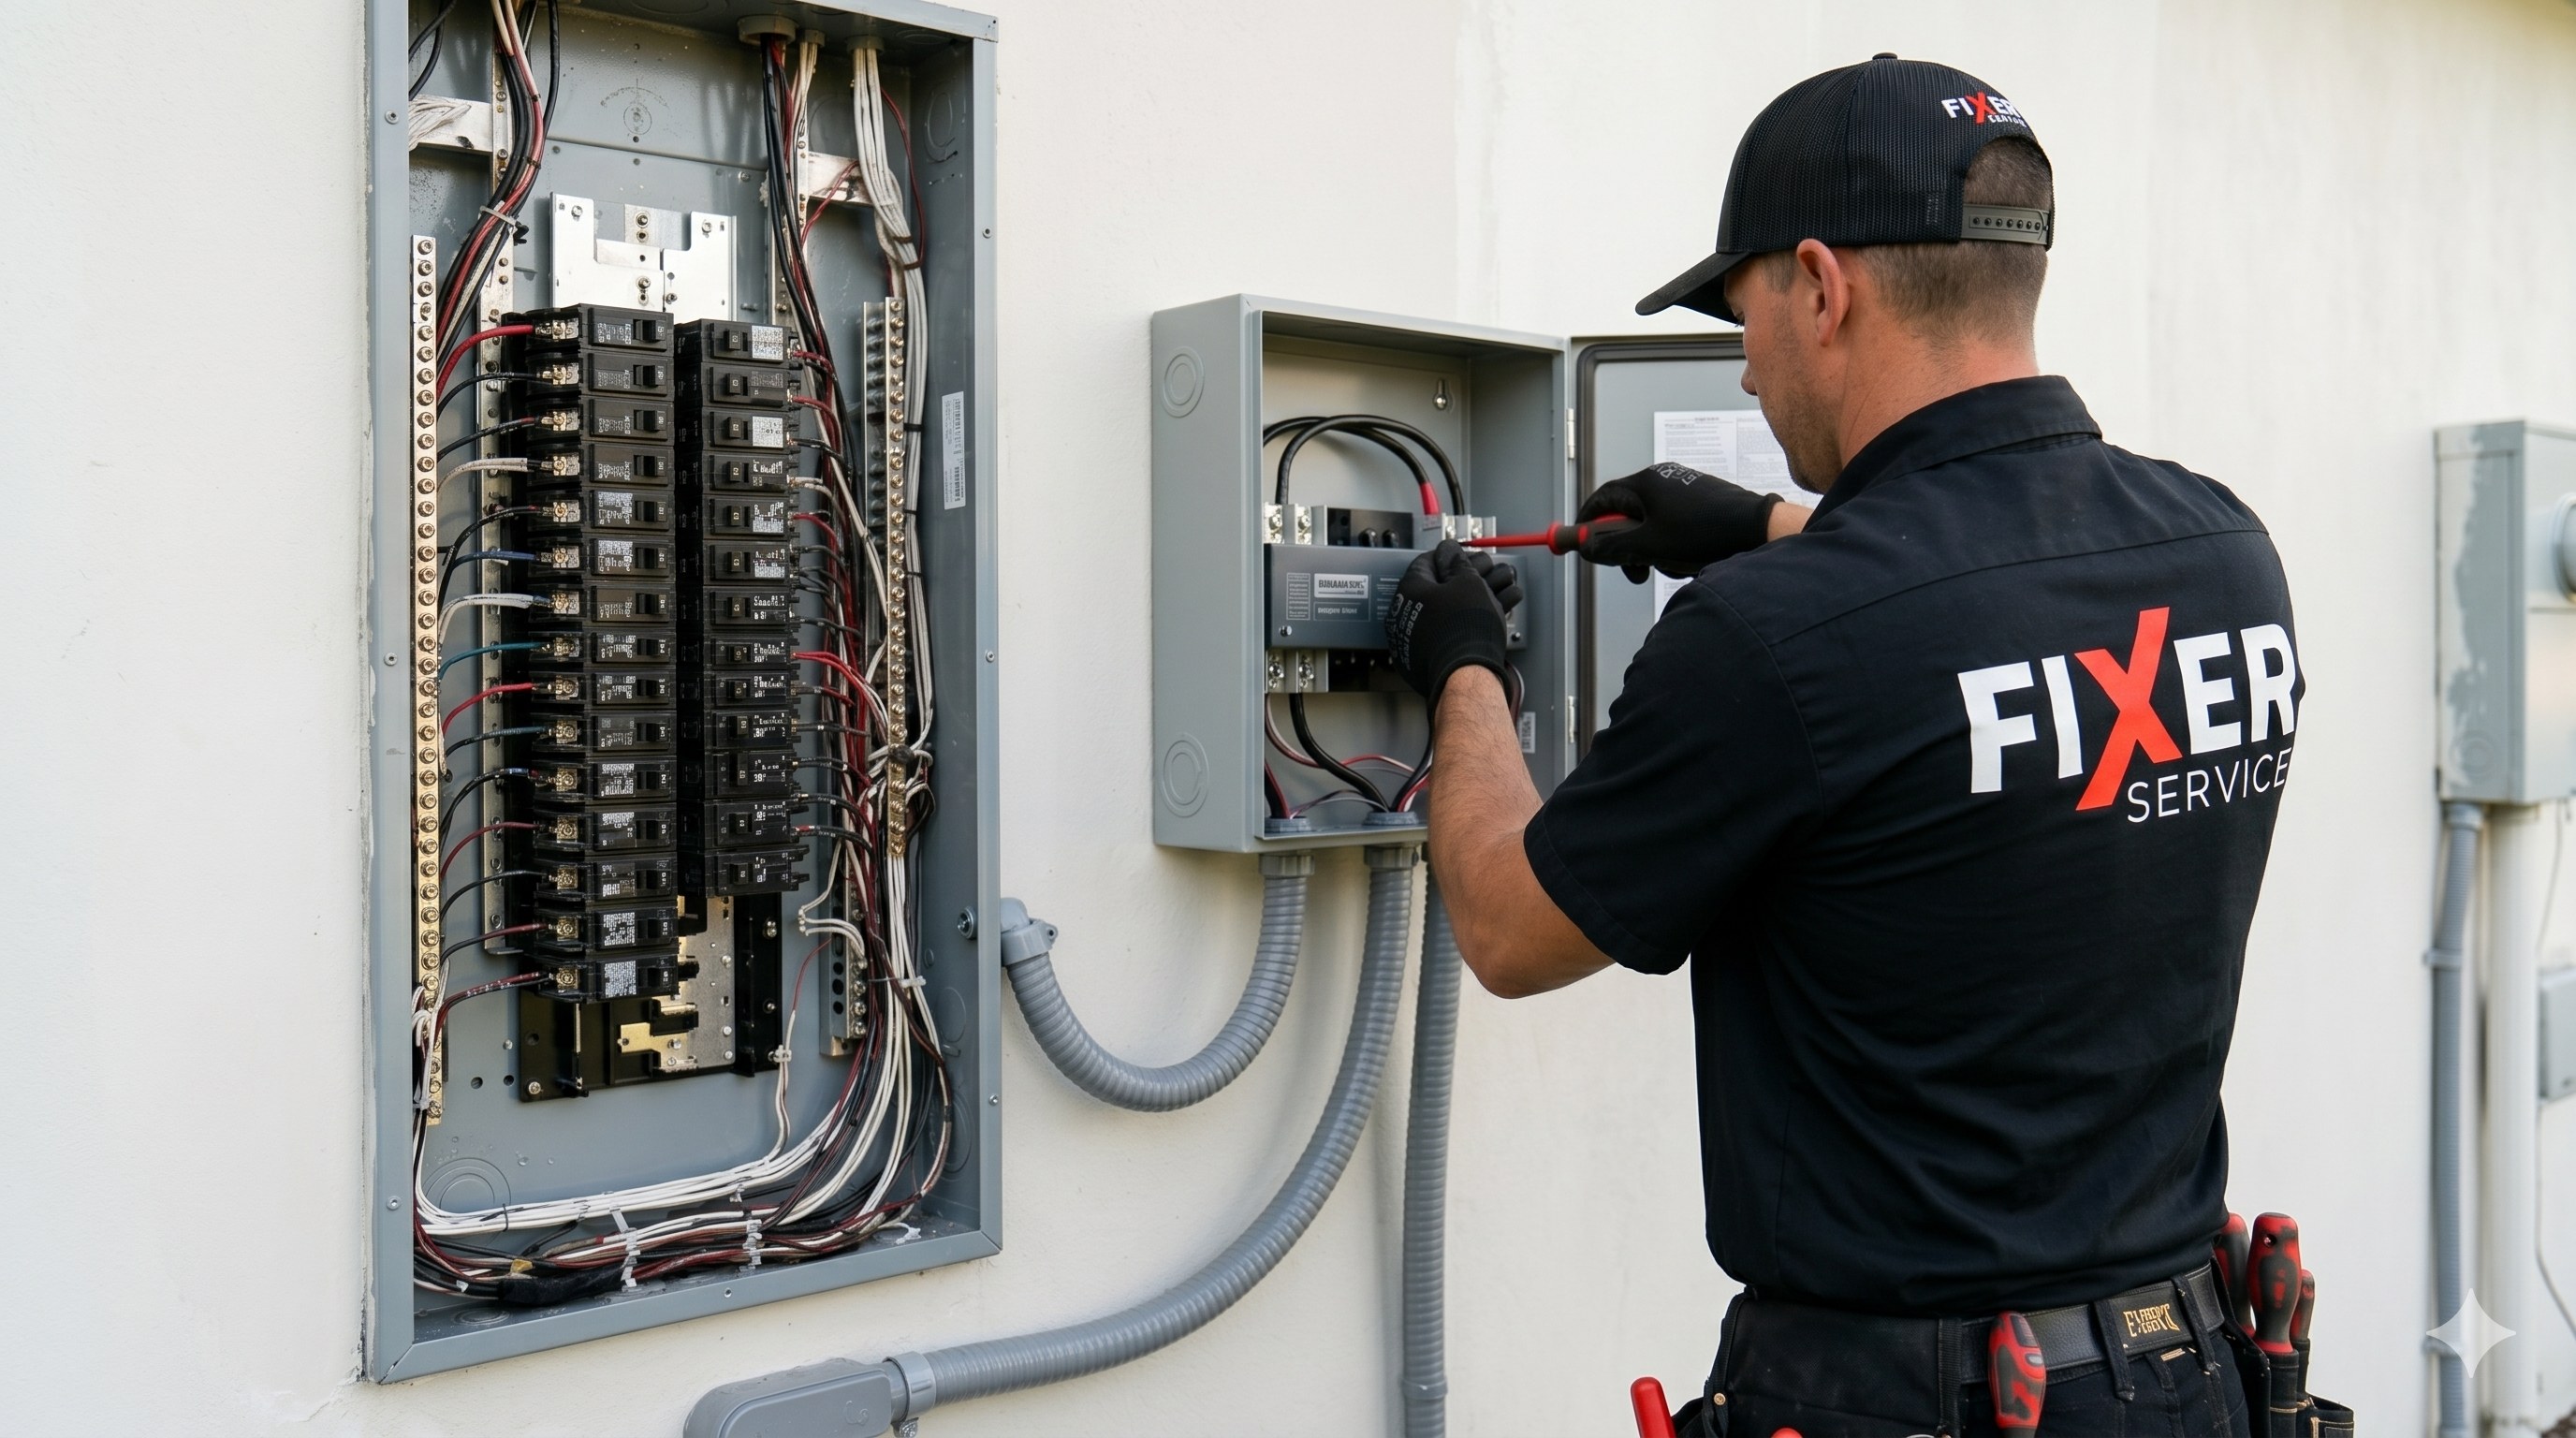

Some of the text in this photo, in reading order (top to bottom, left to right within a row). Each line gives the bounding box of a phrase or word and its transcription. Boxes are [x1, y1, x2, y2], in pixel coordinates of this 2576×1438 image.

[1941, 91, 2022, 125] FIXER
[1957, 607, 2297, 811] FIXER
[2127, 747, 2292, 824] SERVICE
